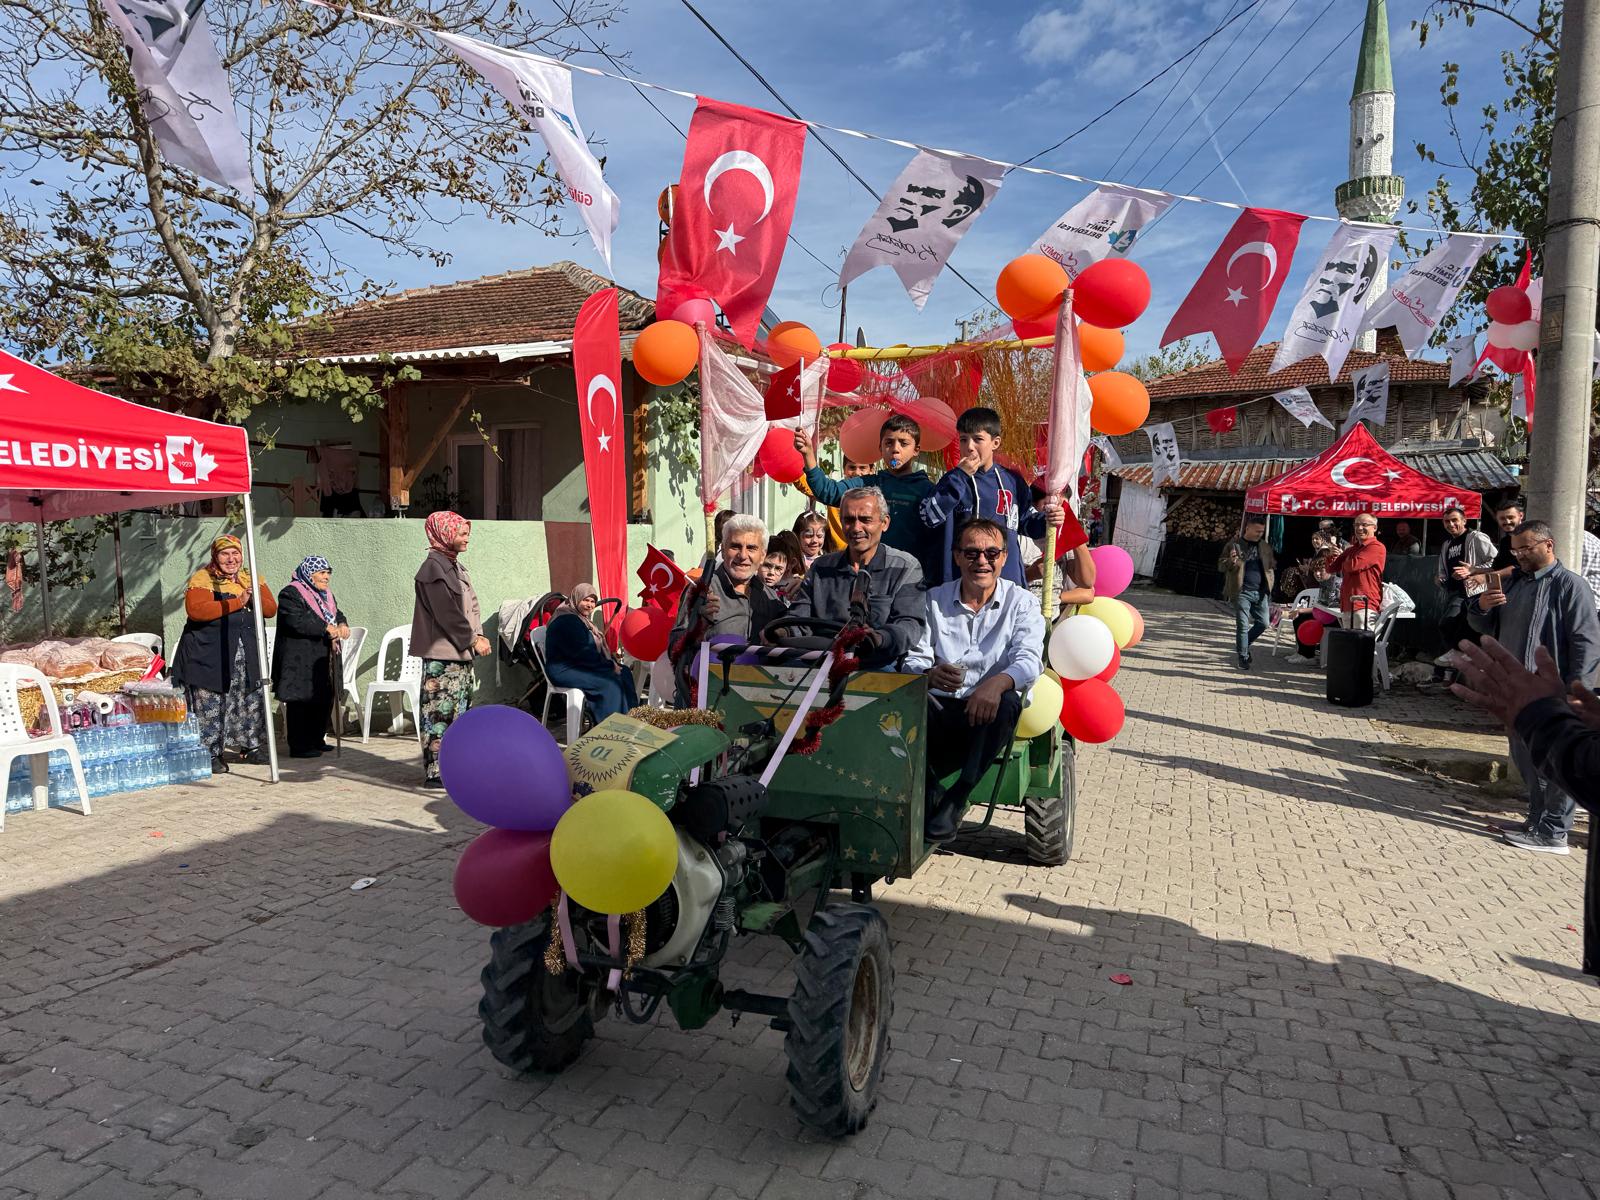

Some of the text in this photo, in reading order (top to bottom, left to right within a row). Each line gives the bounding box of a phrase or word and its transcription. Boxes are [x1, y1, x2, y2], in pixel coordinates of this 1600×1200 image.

[1302, 499, 1445, 512] T.C. İZMİT BELEDİYESİ
